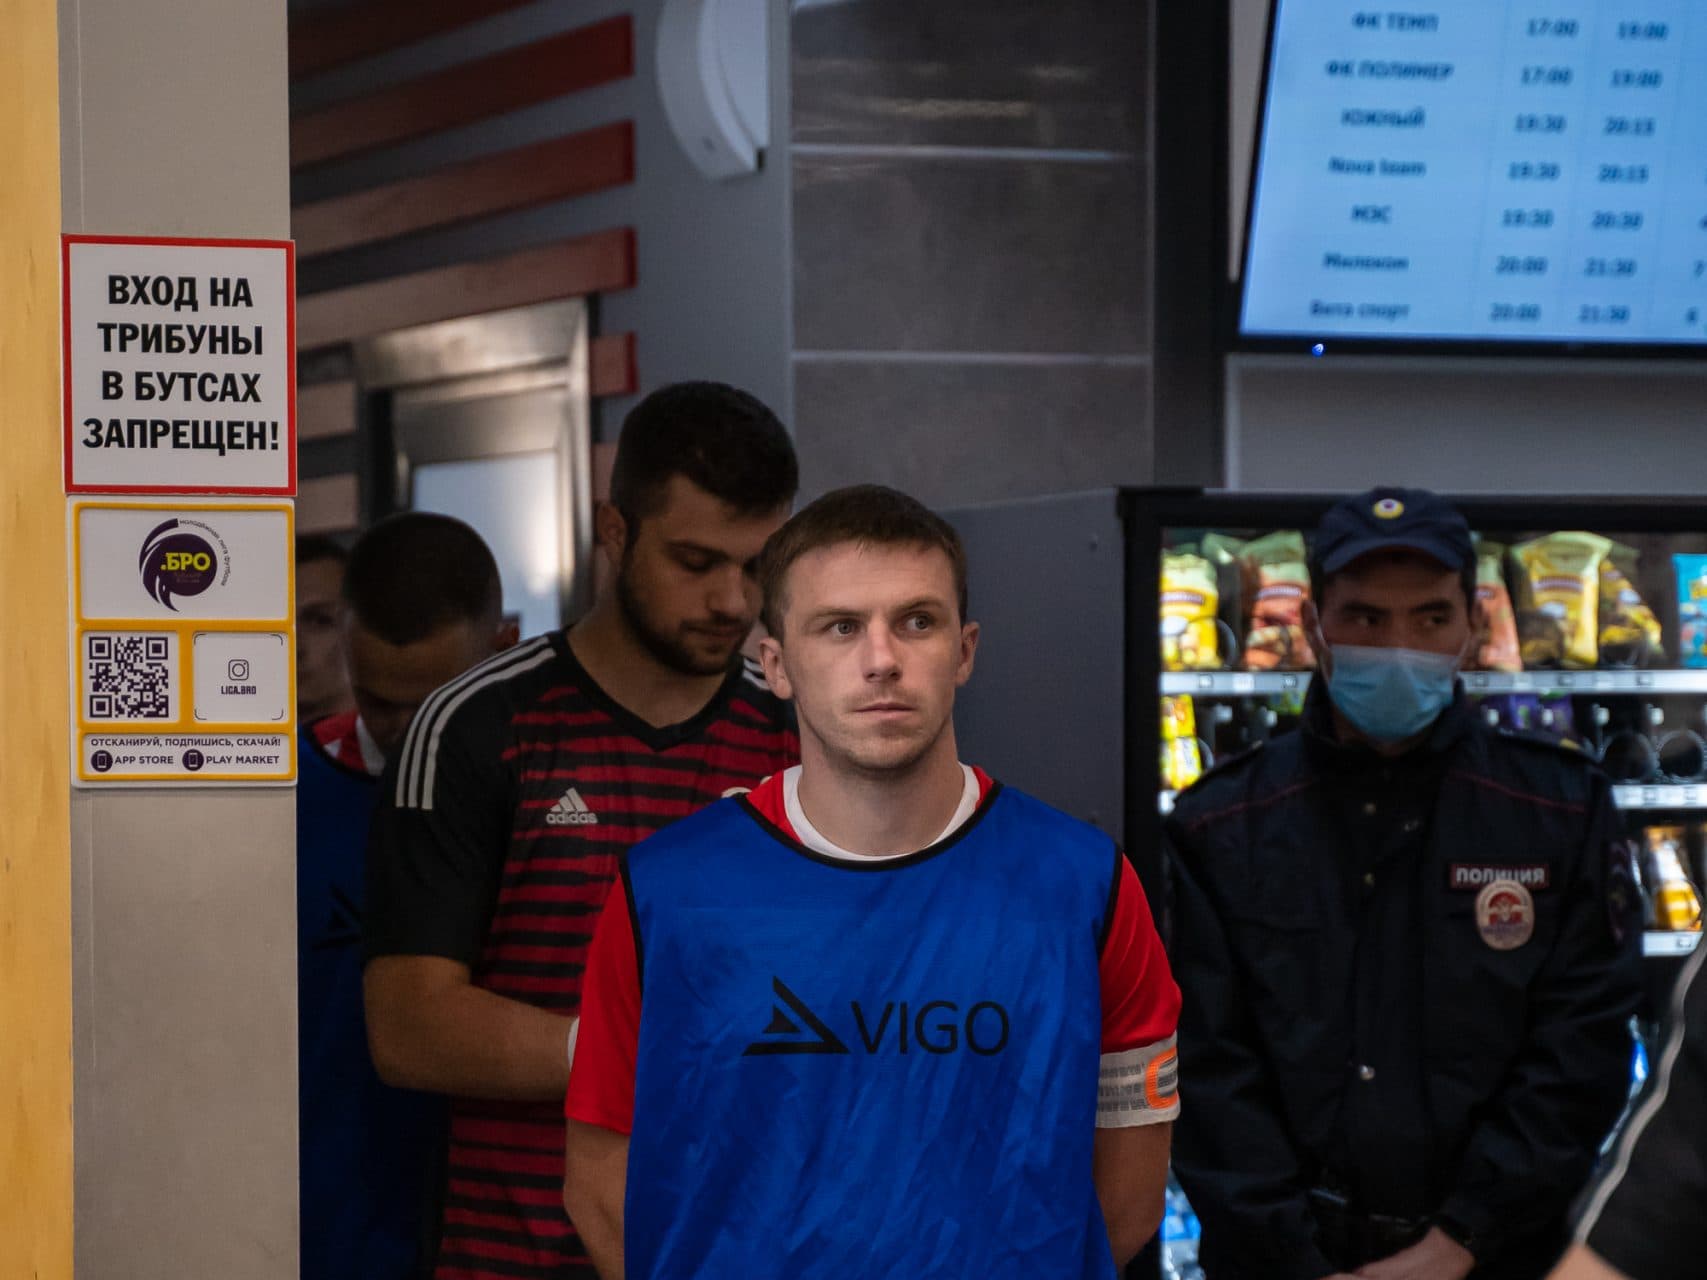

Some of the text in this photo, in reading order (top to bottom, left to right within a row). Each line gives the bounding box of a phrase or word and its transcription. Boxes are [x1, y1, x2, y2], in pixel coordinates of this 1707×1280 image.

[108, 275, 253, 312] ВХОД НА
[97, 322, 263, 355] ТРИБУНЫ
[102, 370, 262, 403] В БУТСАХ
[82, 418, 279, 457] ЗАПРЕЩЕН!
[90, 738, 281, 748] ОТСКАНИРУЙ, ПОДПИШИСЬ, СКАЧАЙ!
[114, 755, 174, 765] APP STORE
[206, 756, 280, 765] PLAY MARKET
[546, 813, 598, 825] adidas
[1456, 867, 1545, 883] ПОЛИЦИЯ
[851, 1001, 1010, 1056] VIGO
